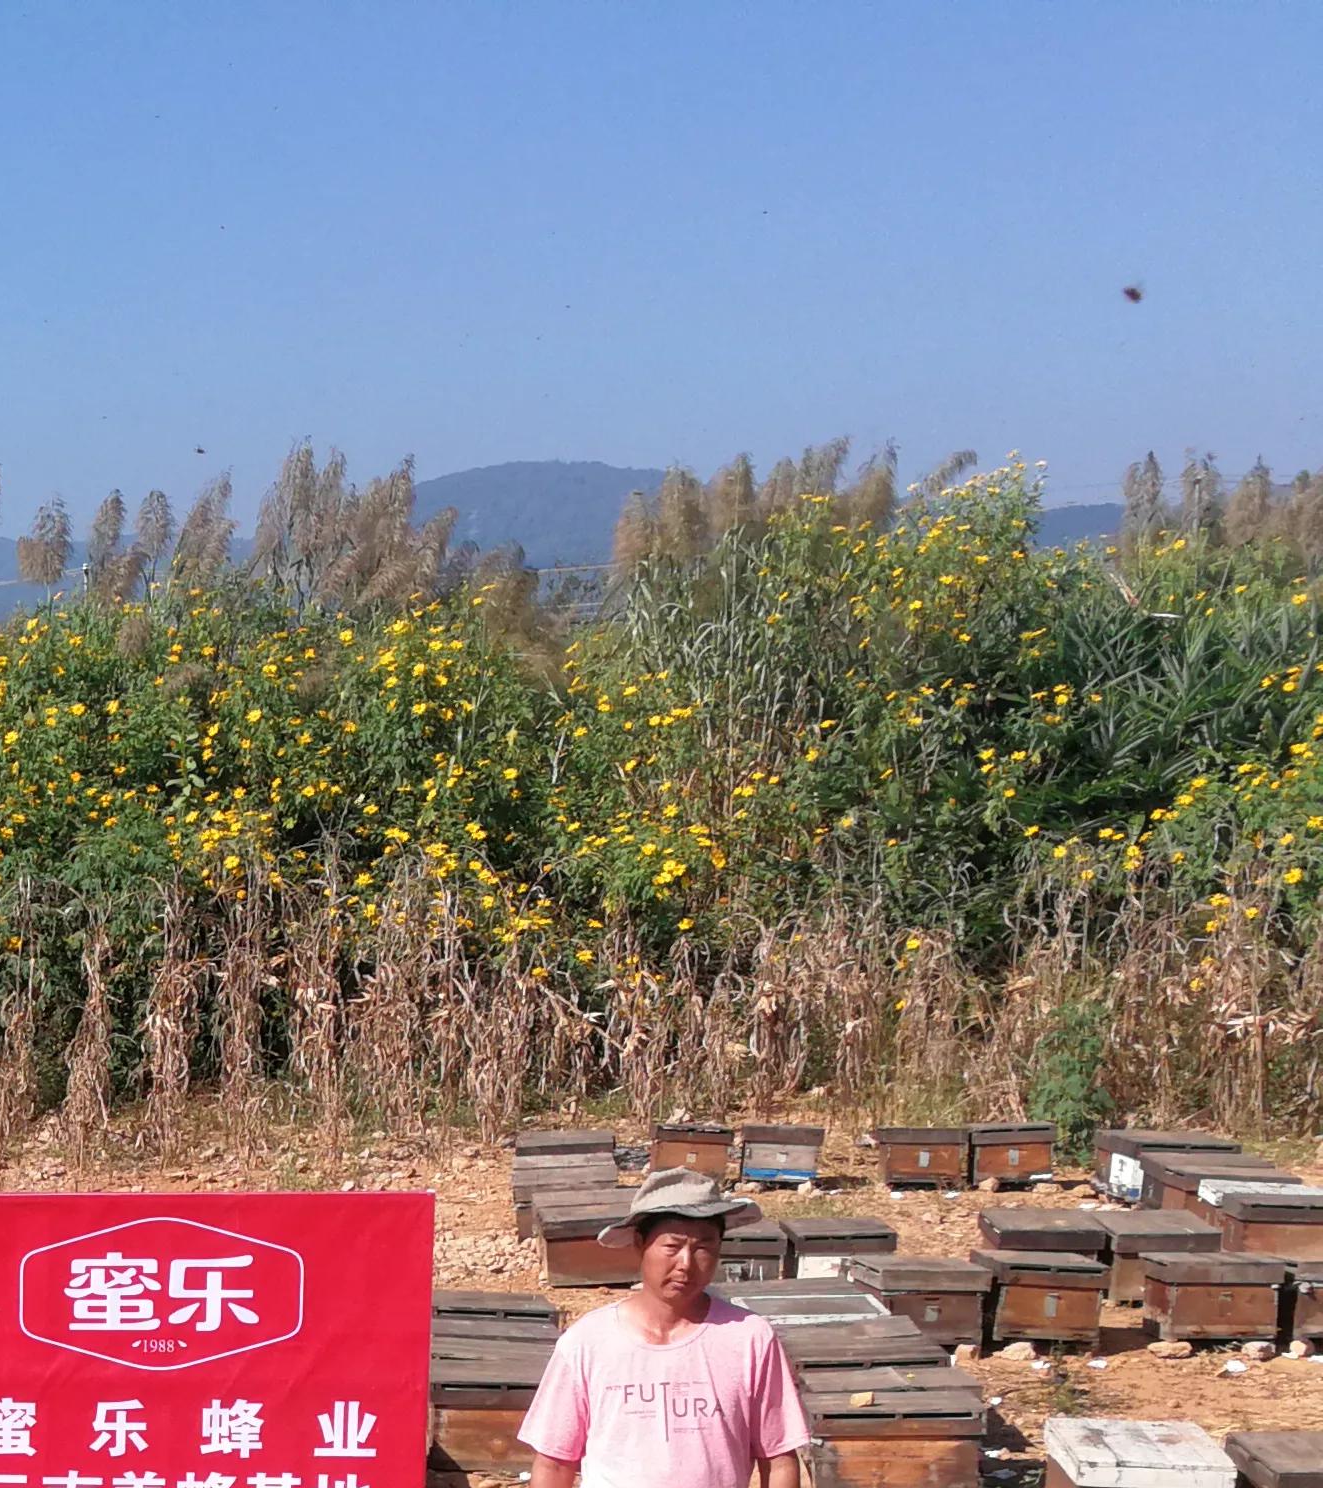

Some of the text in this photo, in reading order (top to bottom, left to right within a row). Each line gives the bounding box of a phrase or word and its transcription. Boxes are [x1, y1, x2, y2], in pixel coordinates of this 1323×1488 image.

[64, 1252, 260, 1332] 蜜乐
[143, 1339, 175, 1353] 1988
[624, 1382, 726, 1442] FUTURA
